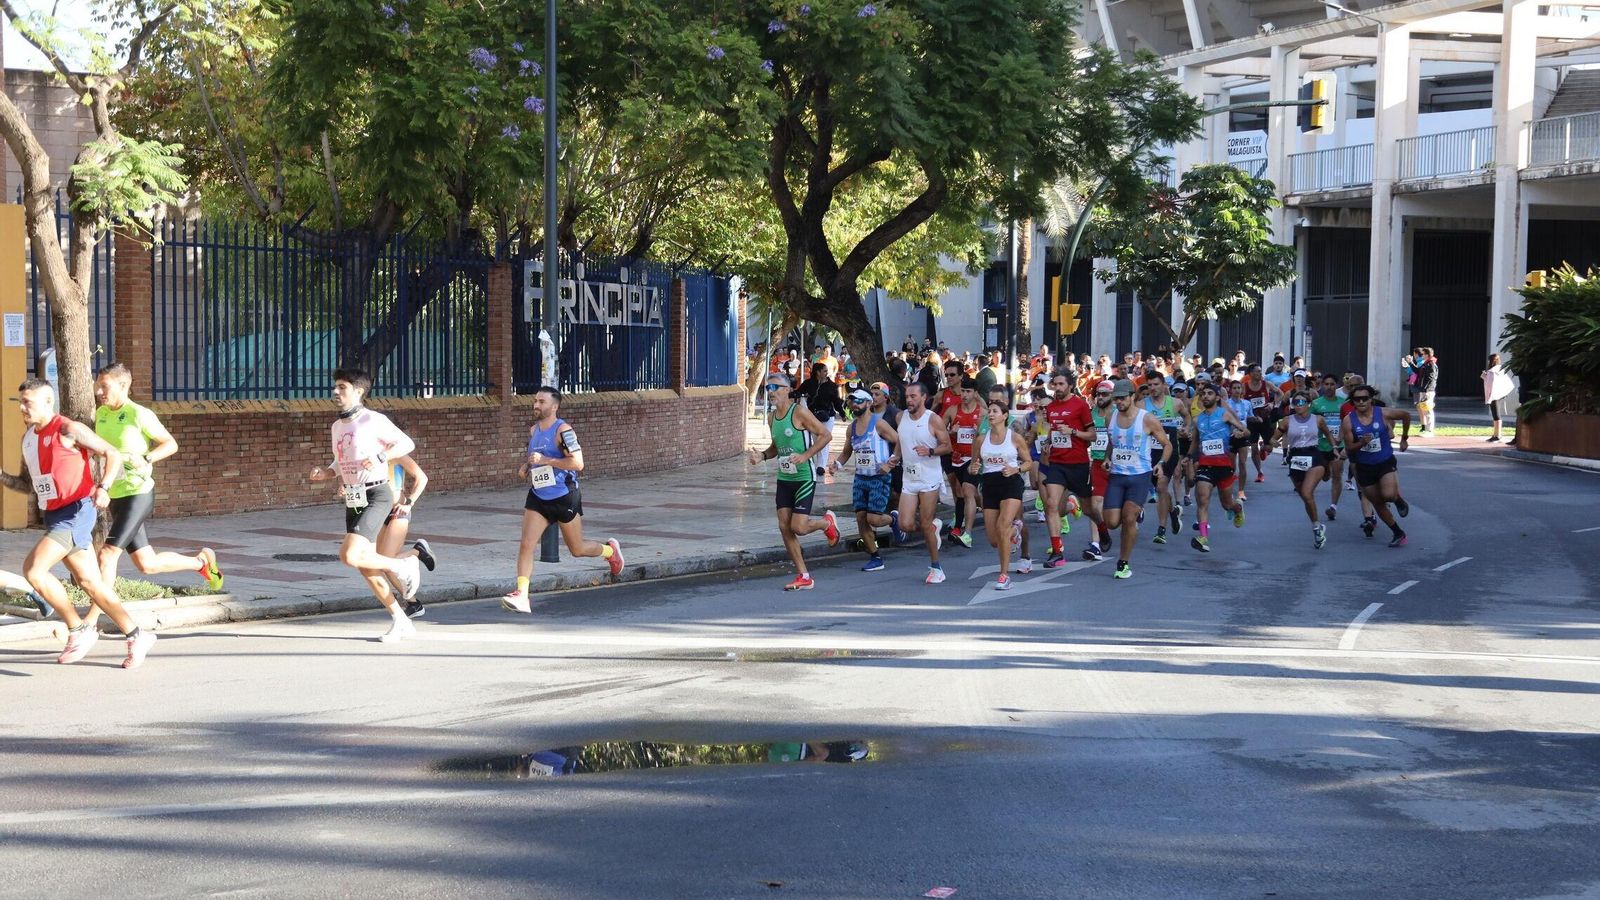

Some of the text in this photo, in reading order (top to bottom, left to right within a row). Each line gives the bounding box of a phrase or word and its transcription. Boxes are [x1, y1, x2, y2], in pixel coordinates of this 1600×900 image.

[1227, 137, 1250, 147] CORNER
[1227, 146, 1262, 156] MALAGUISTA
[534, 473, 550, 482] 448
